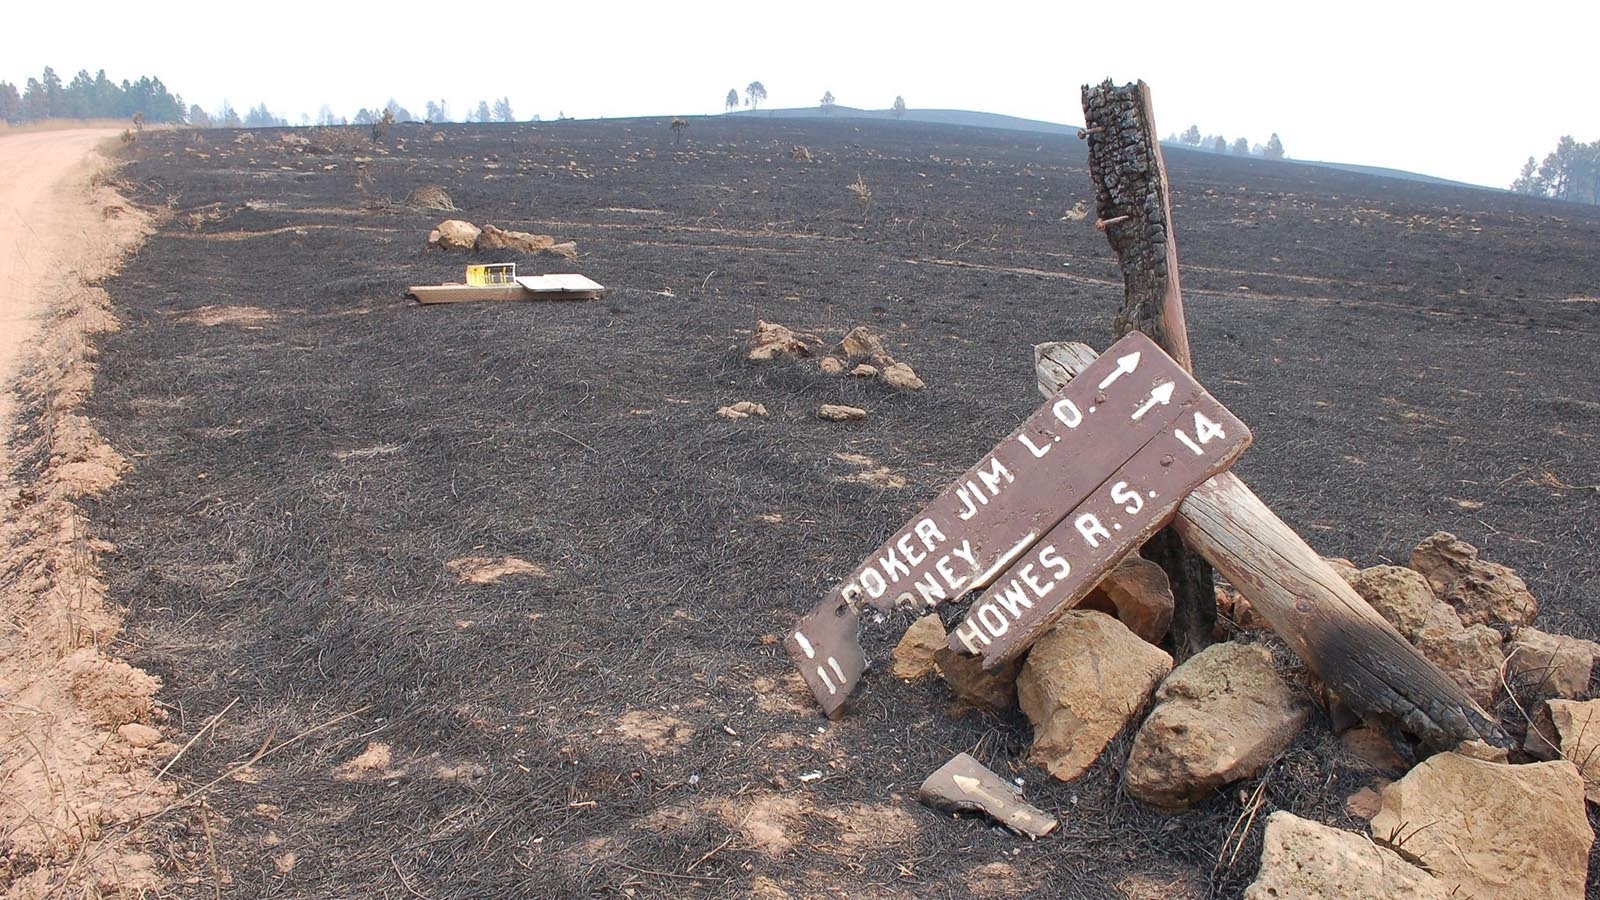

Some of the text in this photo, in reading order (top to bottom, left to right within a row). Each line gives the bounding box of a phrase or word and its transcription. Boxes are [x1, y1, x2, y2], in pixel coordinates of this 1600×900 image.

[841, 518, 946, 616] POKER
[957, 457, 1014, 521] JIM
[956, 545, 1071, 655] HOWES
[1174, 411, 1226, 456] 14
[817, 656, 847, 695] 11
